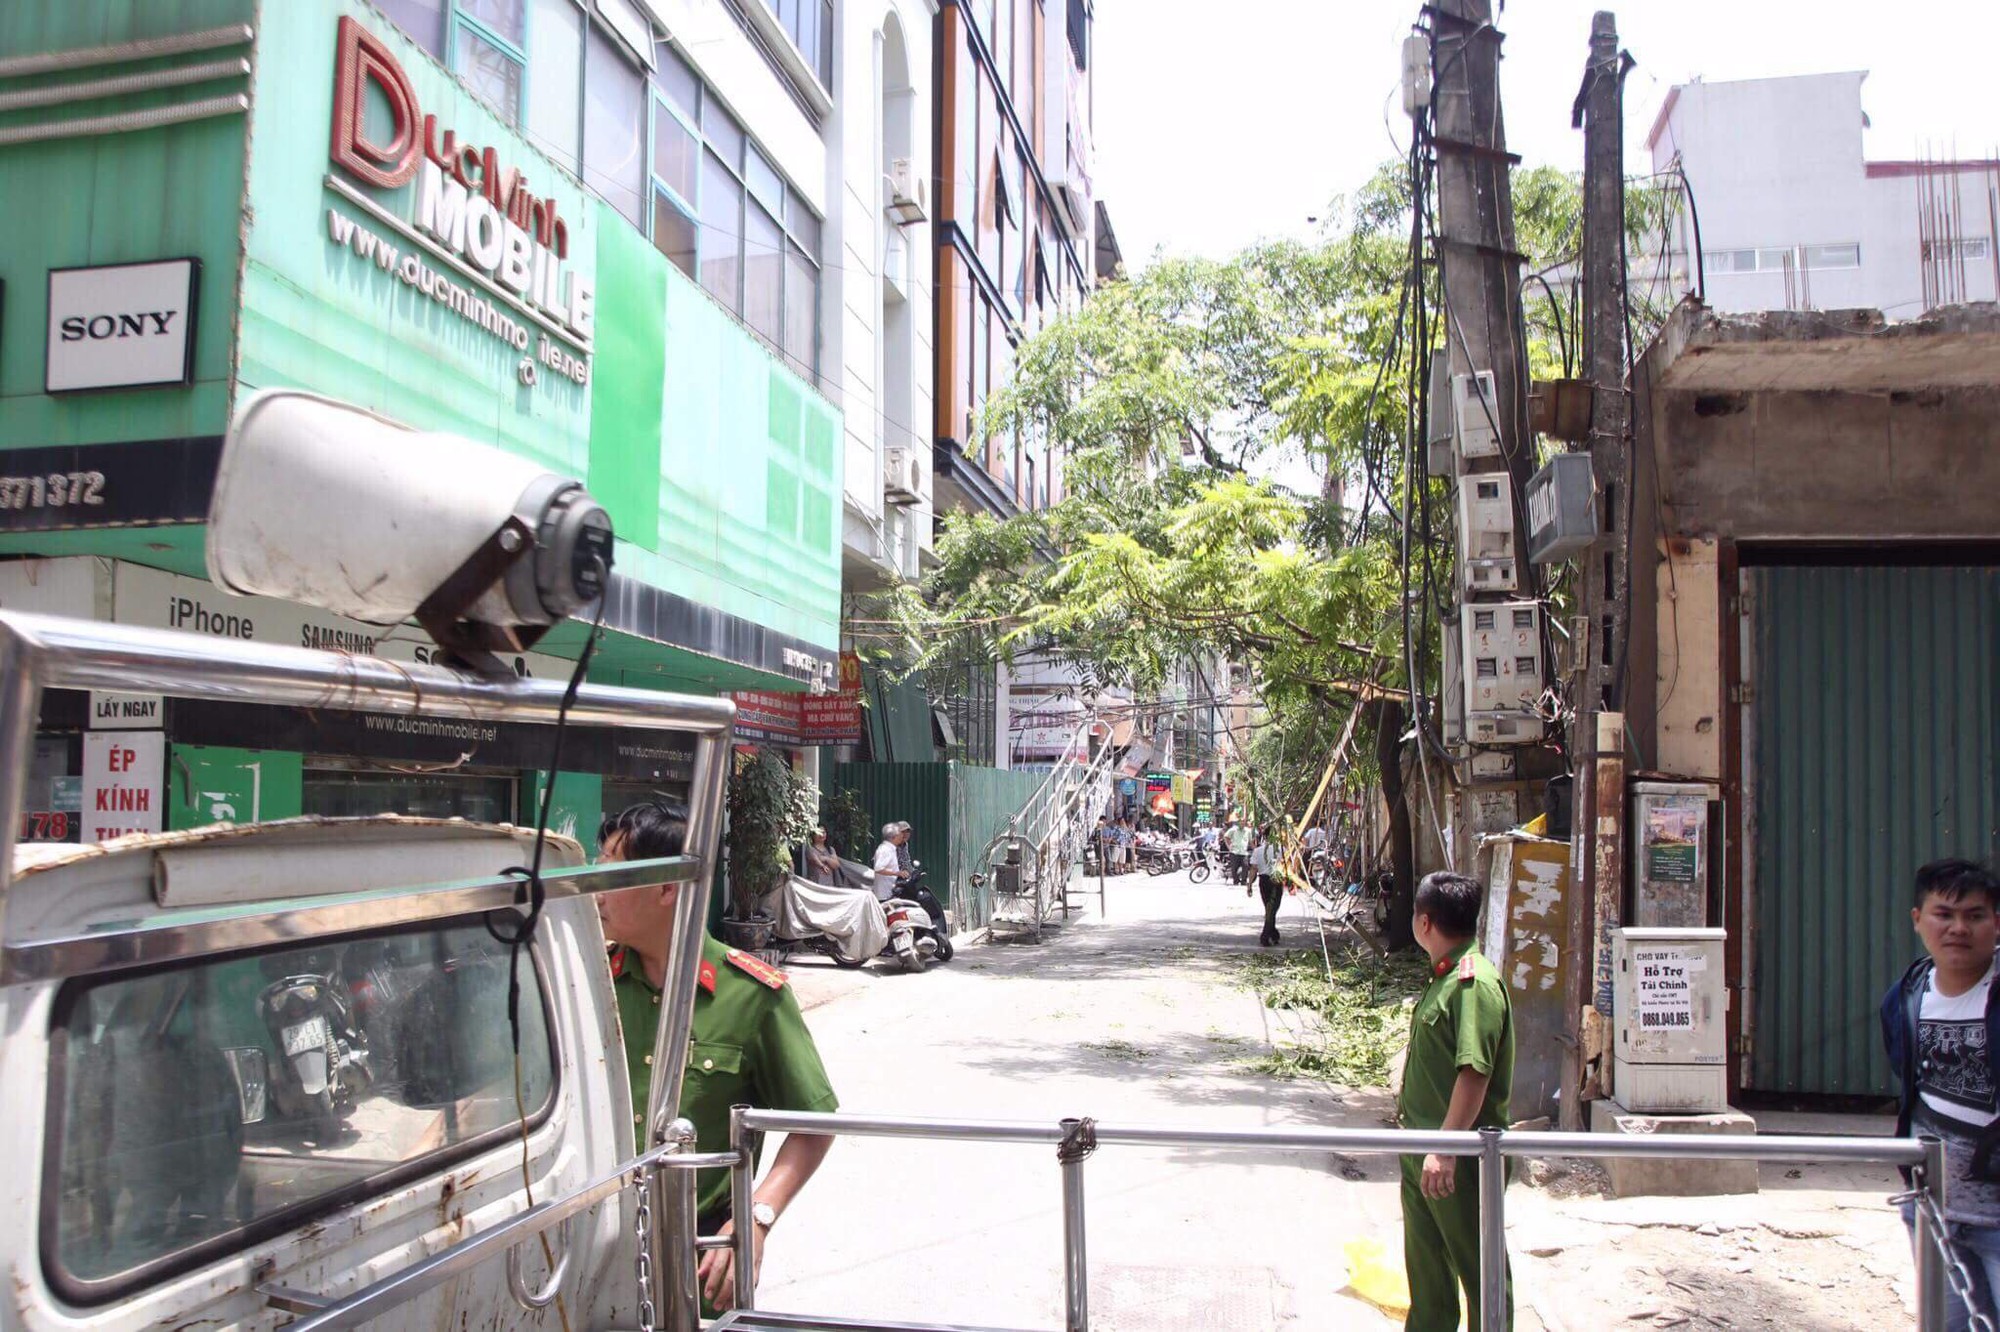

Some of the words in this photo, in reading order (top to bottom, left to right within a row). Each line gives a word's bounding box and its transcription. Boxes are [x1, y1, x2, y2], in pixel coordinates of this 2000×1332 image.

[413, 156, 593, 345] MOBILE
[61, 311, 177, 342] SONY
[170, 597, 254, 640] iPhone
[97, 696, 119, 718] LẤY
[123, 701, 157, 718] NGAY
[109, 744, 136, 772] ÉP
[96, 783, 149, 811] KÍNH
[1655, 952, 1669, 961] VAY
